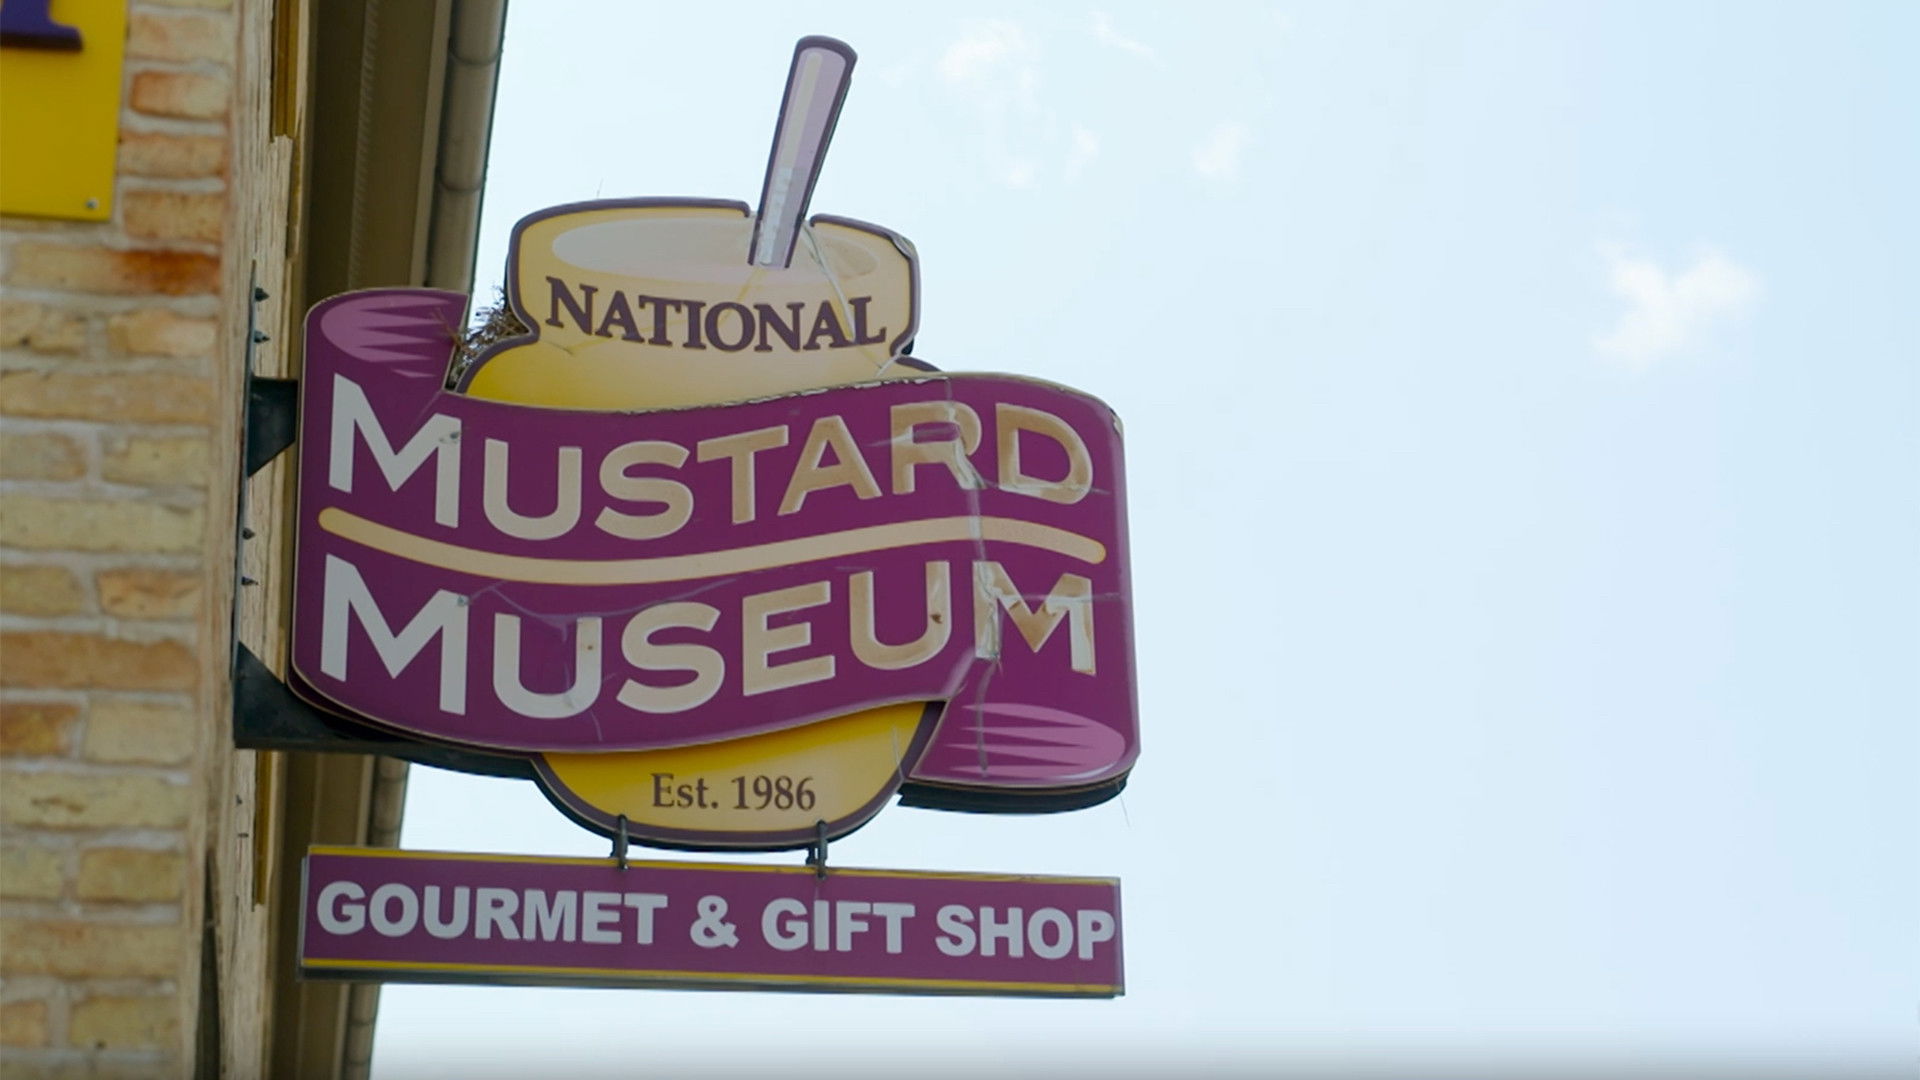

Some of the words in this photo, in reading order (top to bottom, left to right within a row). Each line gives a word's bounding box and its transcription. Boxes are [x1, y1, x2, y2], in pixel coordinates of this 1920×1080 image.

[545, 276, 887, 353] NATIONAL
[328, 373, 1094, 541] MUSTARD
[320, 553, 1097, 719] MUSEUM
[651, 772, 718, 811] Est.
[732, 774, 816, 812] 1986
[316, 880, 668, 946] GOURMET
[689, 895, 739, 950] &
[761, 897, 915, 954] GIFT
[935, 903, 1116, 960] SHOP
